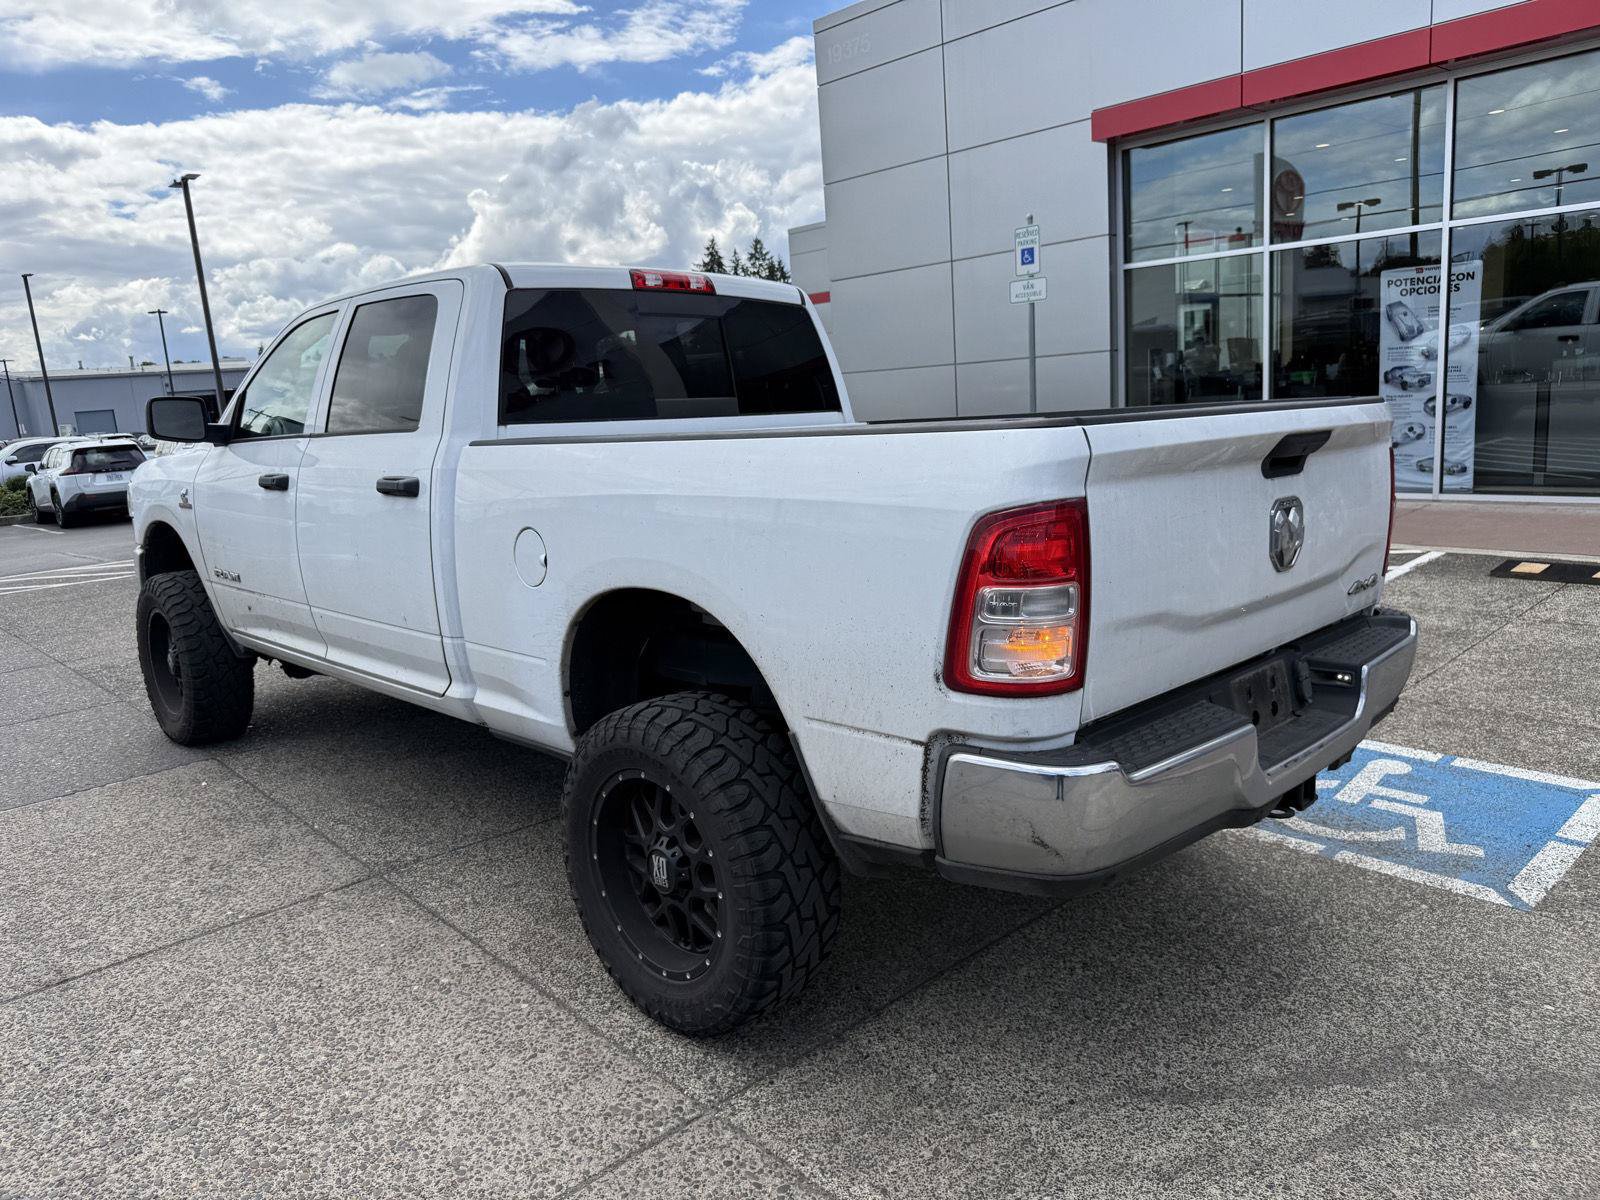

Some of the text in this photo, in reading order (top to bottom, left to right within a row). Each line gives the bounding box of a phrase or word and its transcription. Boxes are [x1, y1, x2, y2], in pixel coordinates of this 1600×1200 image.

[828, 33, 872, 64] 19375
[1017, 237, 1037, 247] PARKING
[1450, 271, 1475, 282] CON
[1022, 282, 1034, 290] VAN
[1015, 290, 1042, 299] ACCESSIBLE
